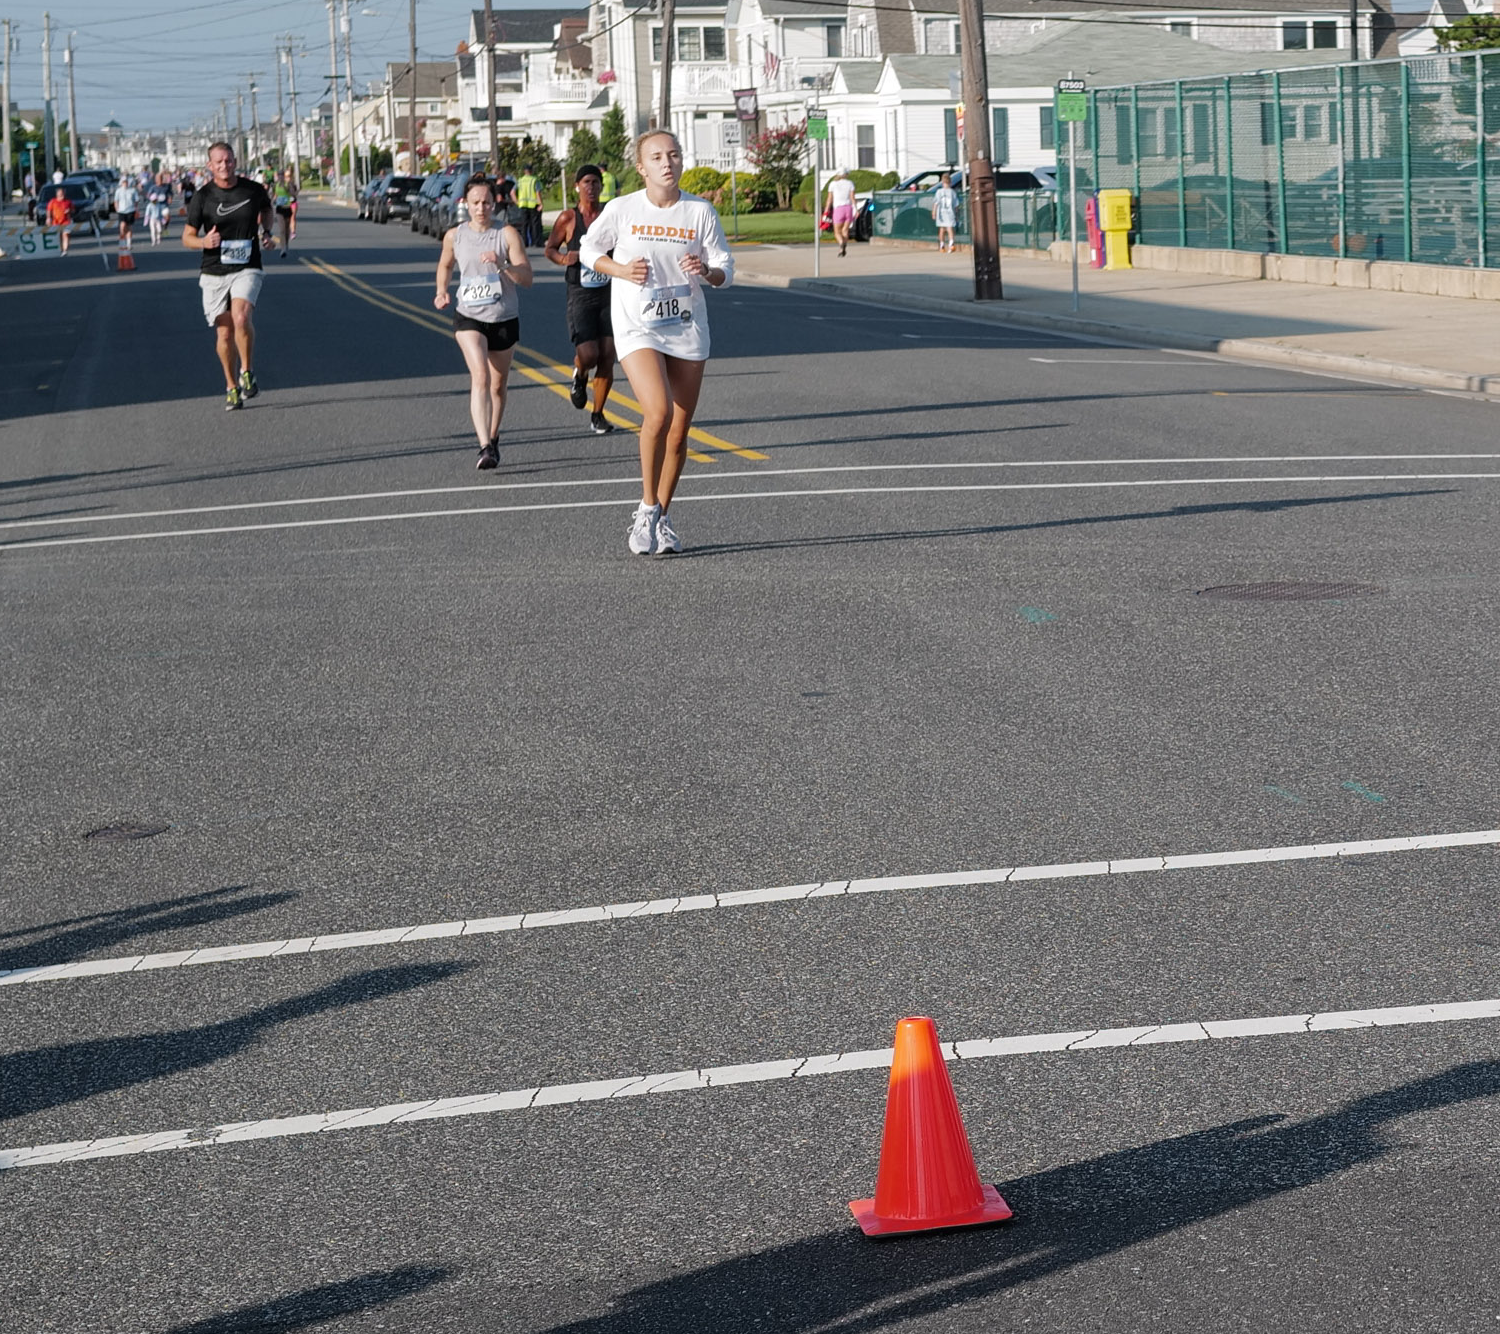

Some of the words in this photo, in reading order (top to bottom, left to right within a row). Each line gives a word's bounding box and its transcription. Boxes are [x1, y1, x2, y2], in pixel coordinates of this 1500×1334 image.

[631, 224, 696, 240] MIDDLE
[472, 285, 492, 299] 322
[656, 299, 680, 318] 418
